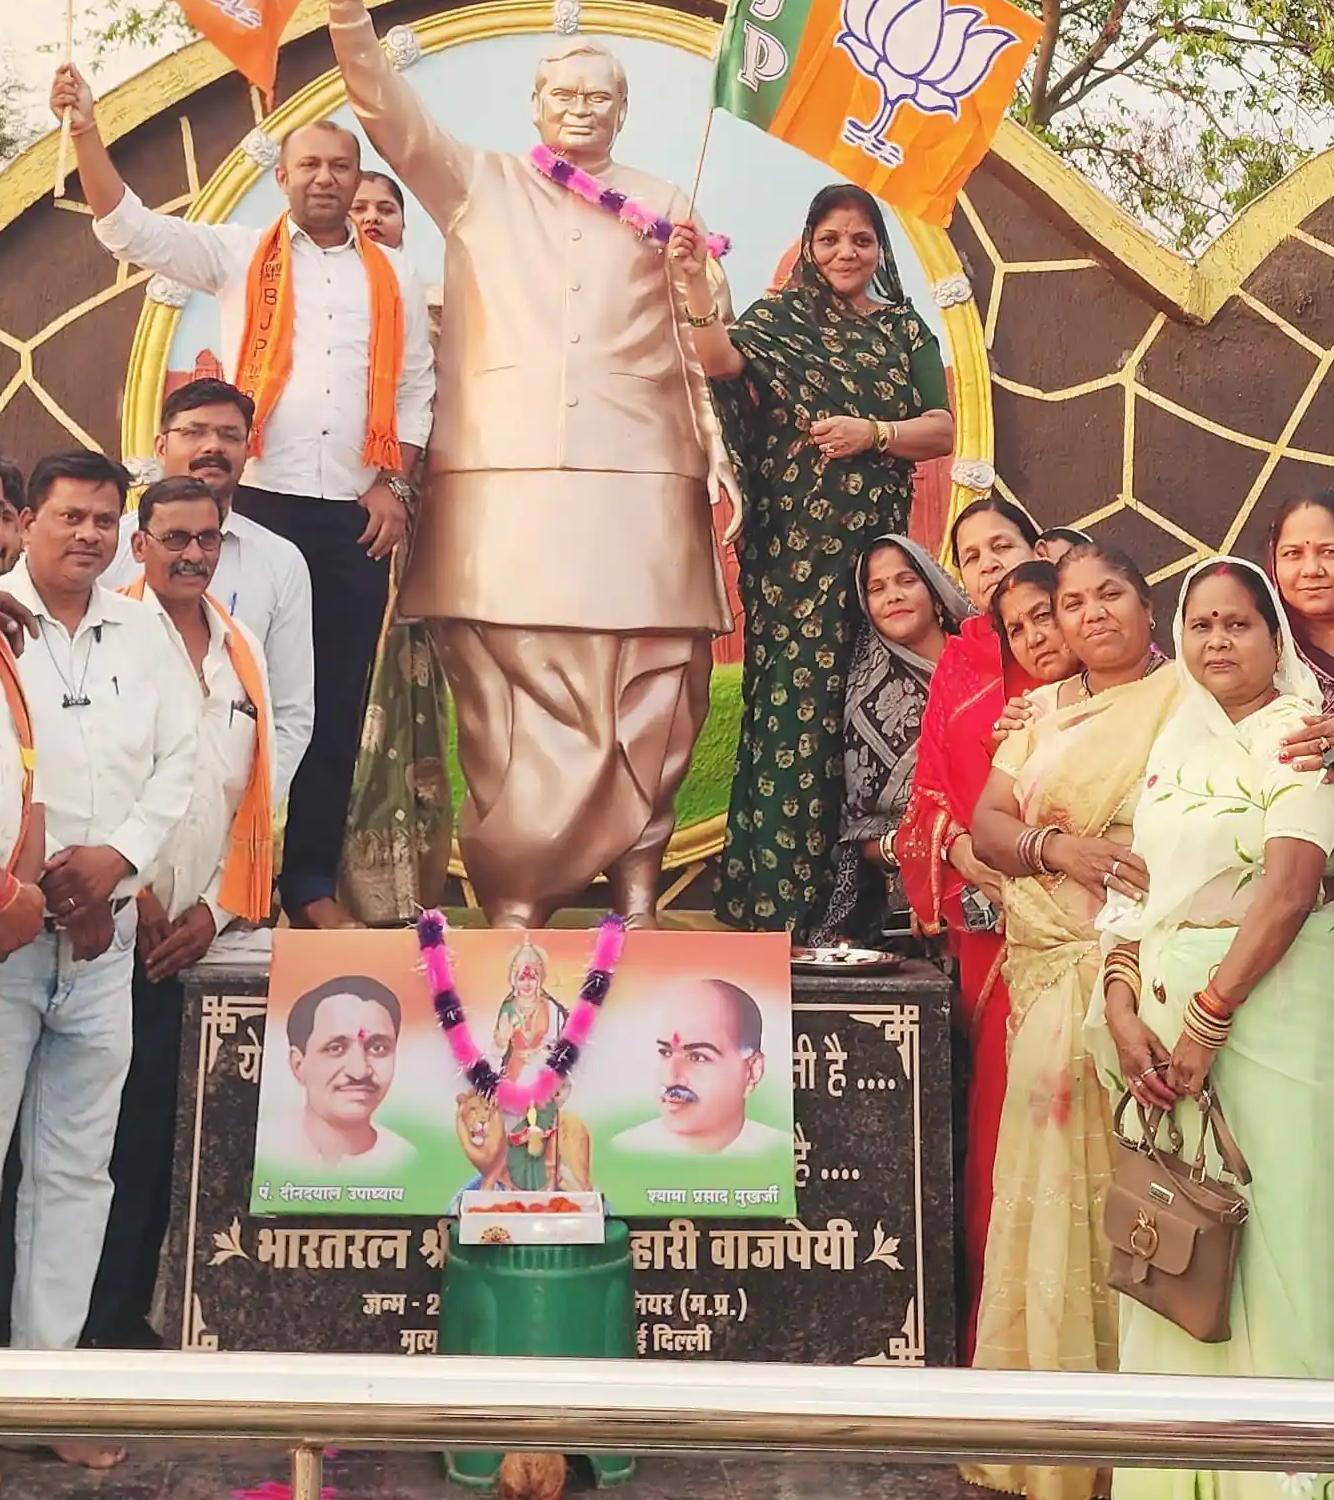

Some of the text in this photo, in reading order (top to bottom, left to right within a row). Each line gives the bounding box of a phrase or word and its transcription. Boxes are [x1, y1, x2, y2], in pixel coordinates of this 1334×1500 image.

[253, 287, 278, 358] BJP
[238, 1025, 263, 1083] ये
[823, 1032, 848, 1097] है
[279, 1182, 342, 1202] दीनदयाल
[347, 1186, 405, 1202] उपाध्याय
[692, 1188, 729, 1205] प्रसाद
[734, 1185, 780, 1208] मुखर्जी
[258, 1228, 412, 1270] भारतरत्न
[630, 1218, 701, 1270] हारी
[709, 1218, 859, 1270] वाजपेयी
[361, 1293, 408, 1316] जन्म
[680, 1288, 749, 1322] (म.प्र.)
[653, 1323, 713, 1352] दिल्ली
